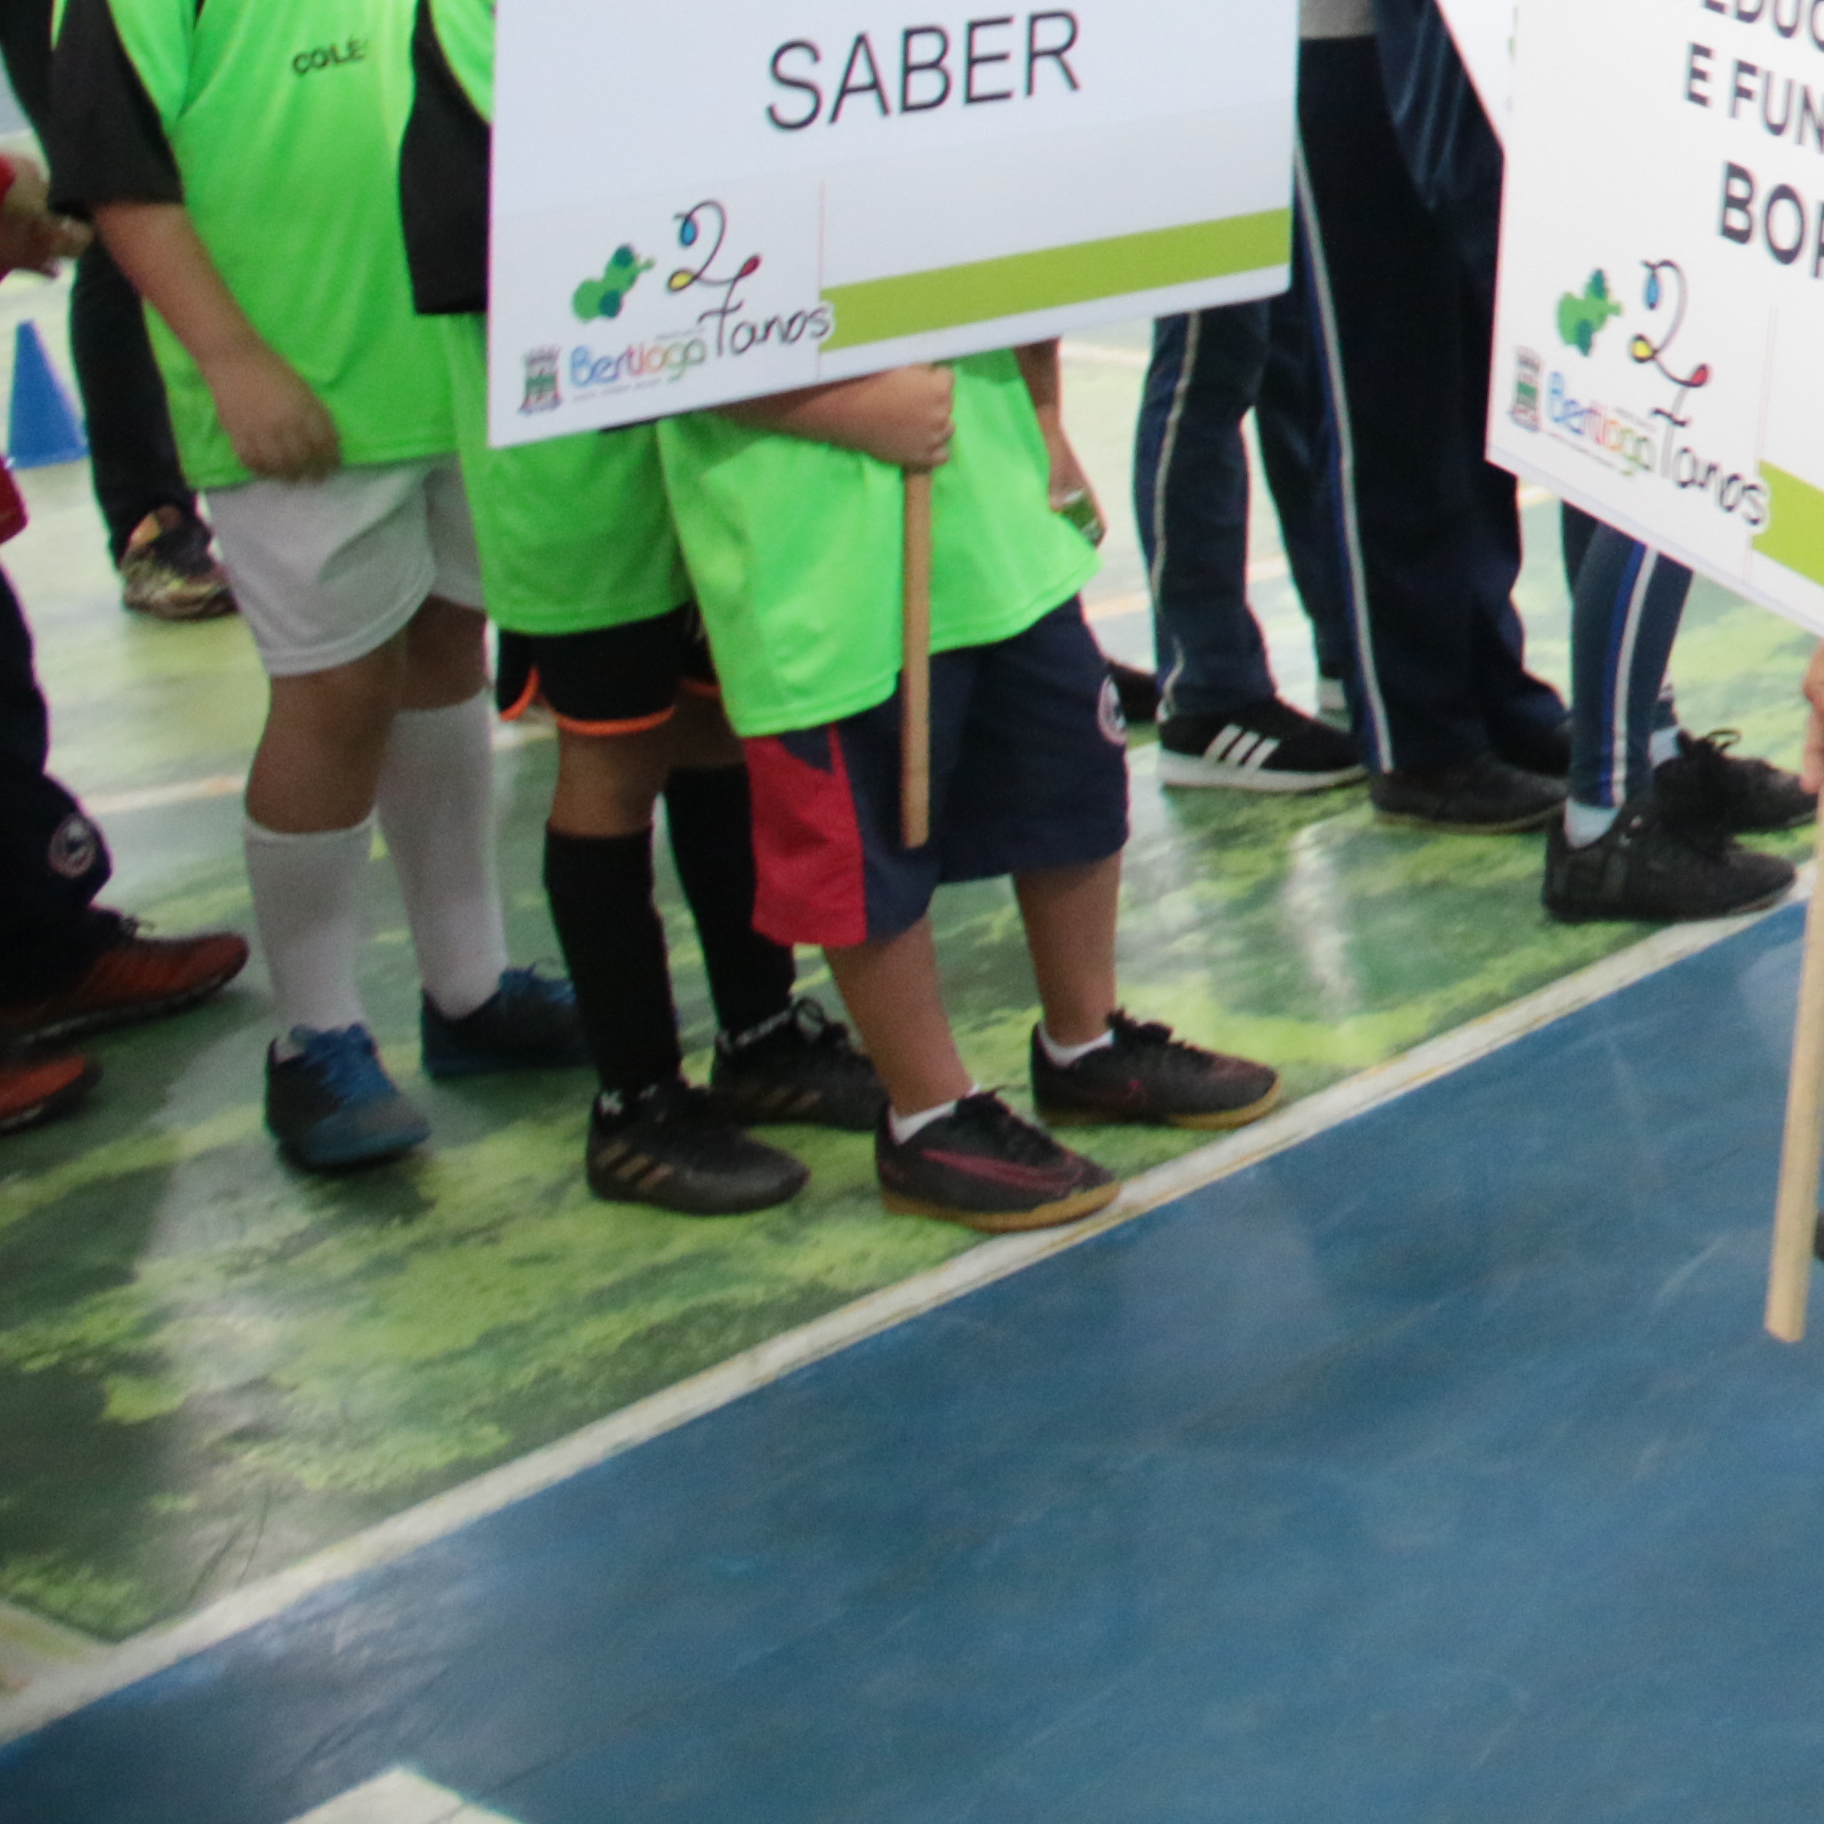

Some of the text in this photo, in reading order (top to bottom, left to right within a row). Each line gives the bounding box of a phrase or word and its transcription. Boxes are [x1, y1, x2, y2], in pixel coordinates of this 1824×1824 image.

[765, 8, 1082, 132] SABER
[1684, 41, 1717, 109] E
[568, 342, 710, 388] Bertioga
[1546, 370, 1658, 479] Bertioga
